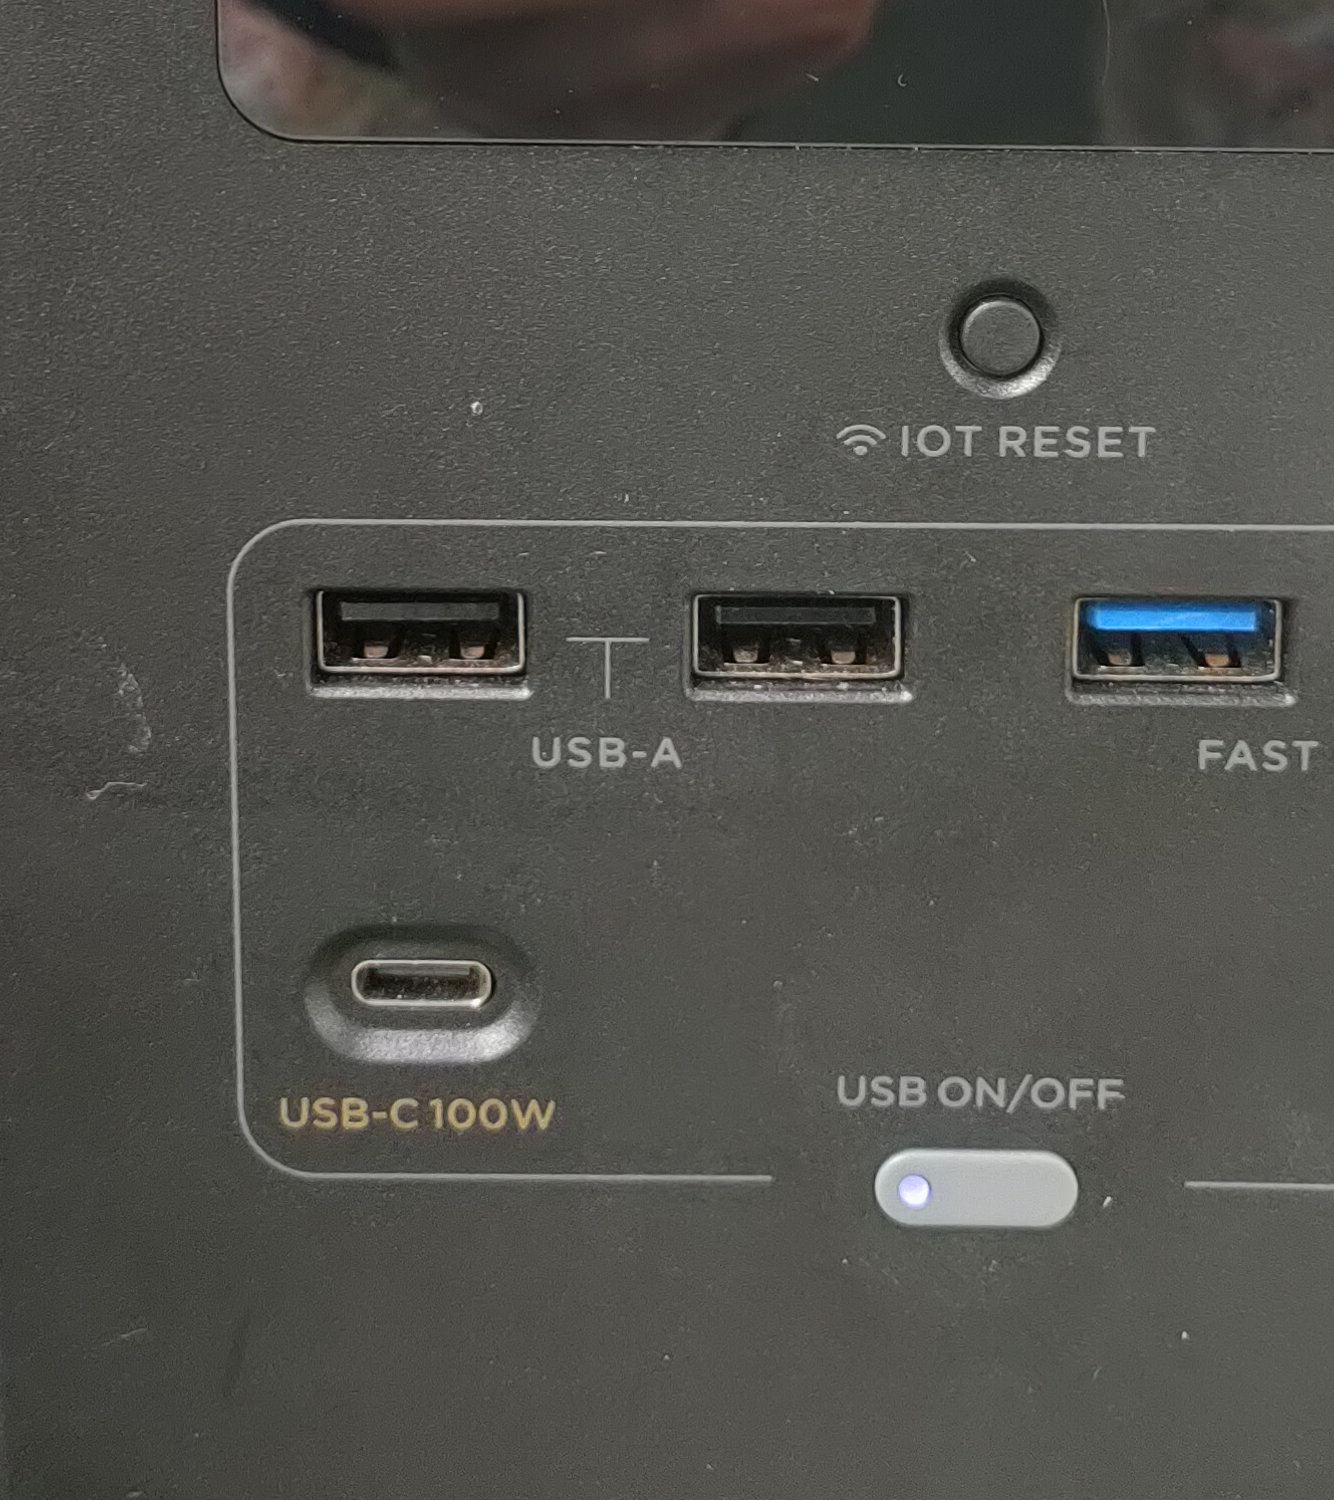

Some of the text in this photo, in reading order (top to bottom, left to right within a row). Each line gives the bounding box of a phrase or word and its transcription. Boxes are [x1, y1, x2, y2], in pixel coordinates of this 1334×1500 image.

[901, 424, 1157, 458] IOT RESET
[532, 736, 682, 768] USB-A
[1197, 739, 1319, 772] FAST
[837, 1073, 1126, 1114] USB ON/OFF
[279, 1097, 557, 1131] USB-C 100W
